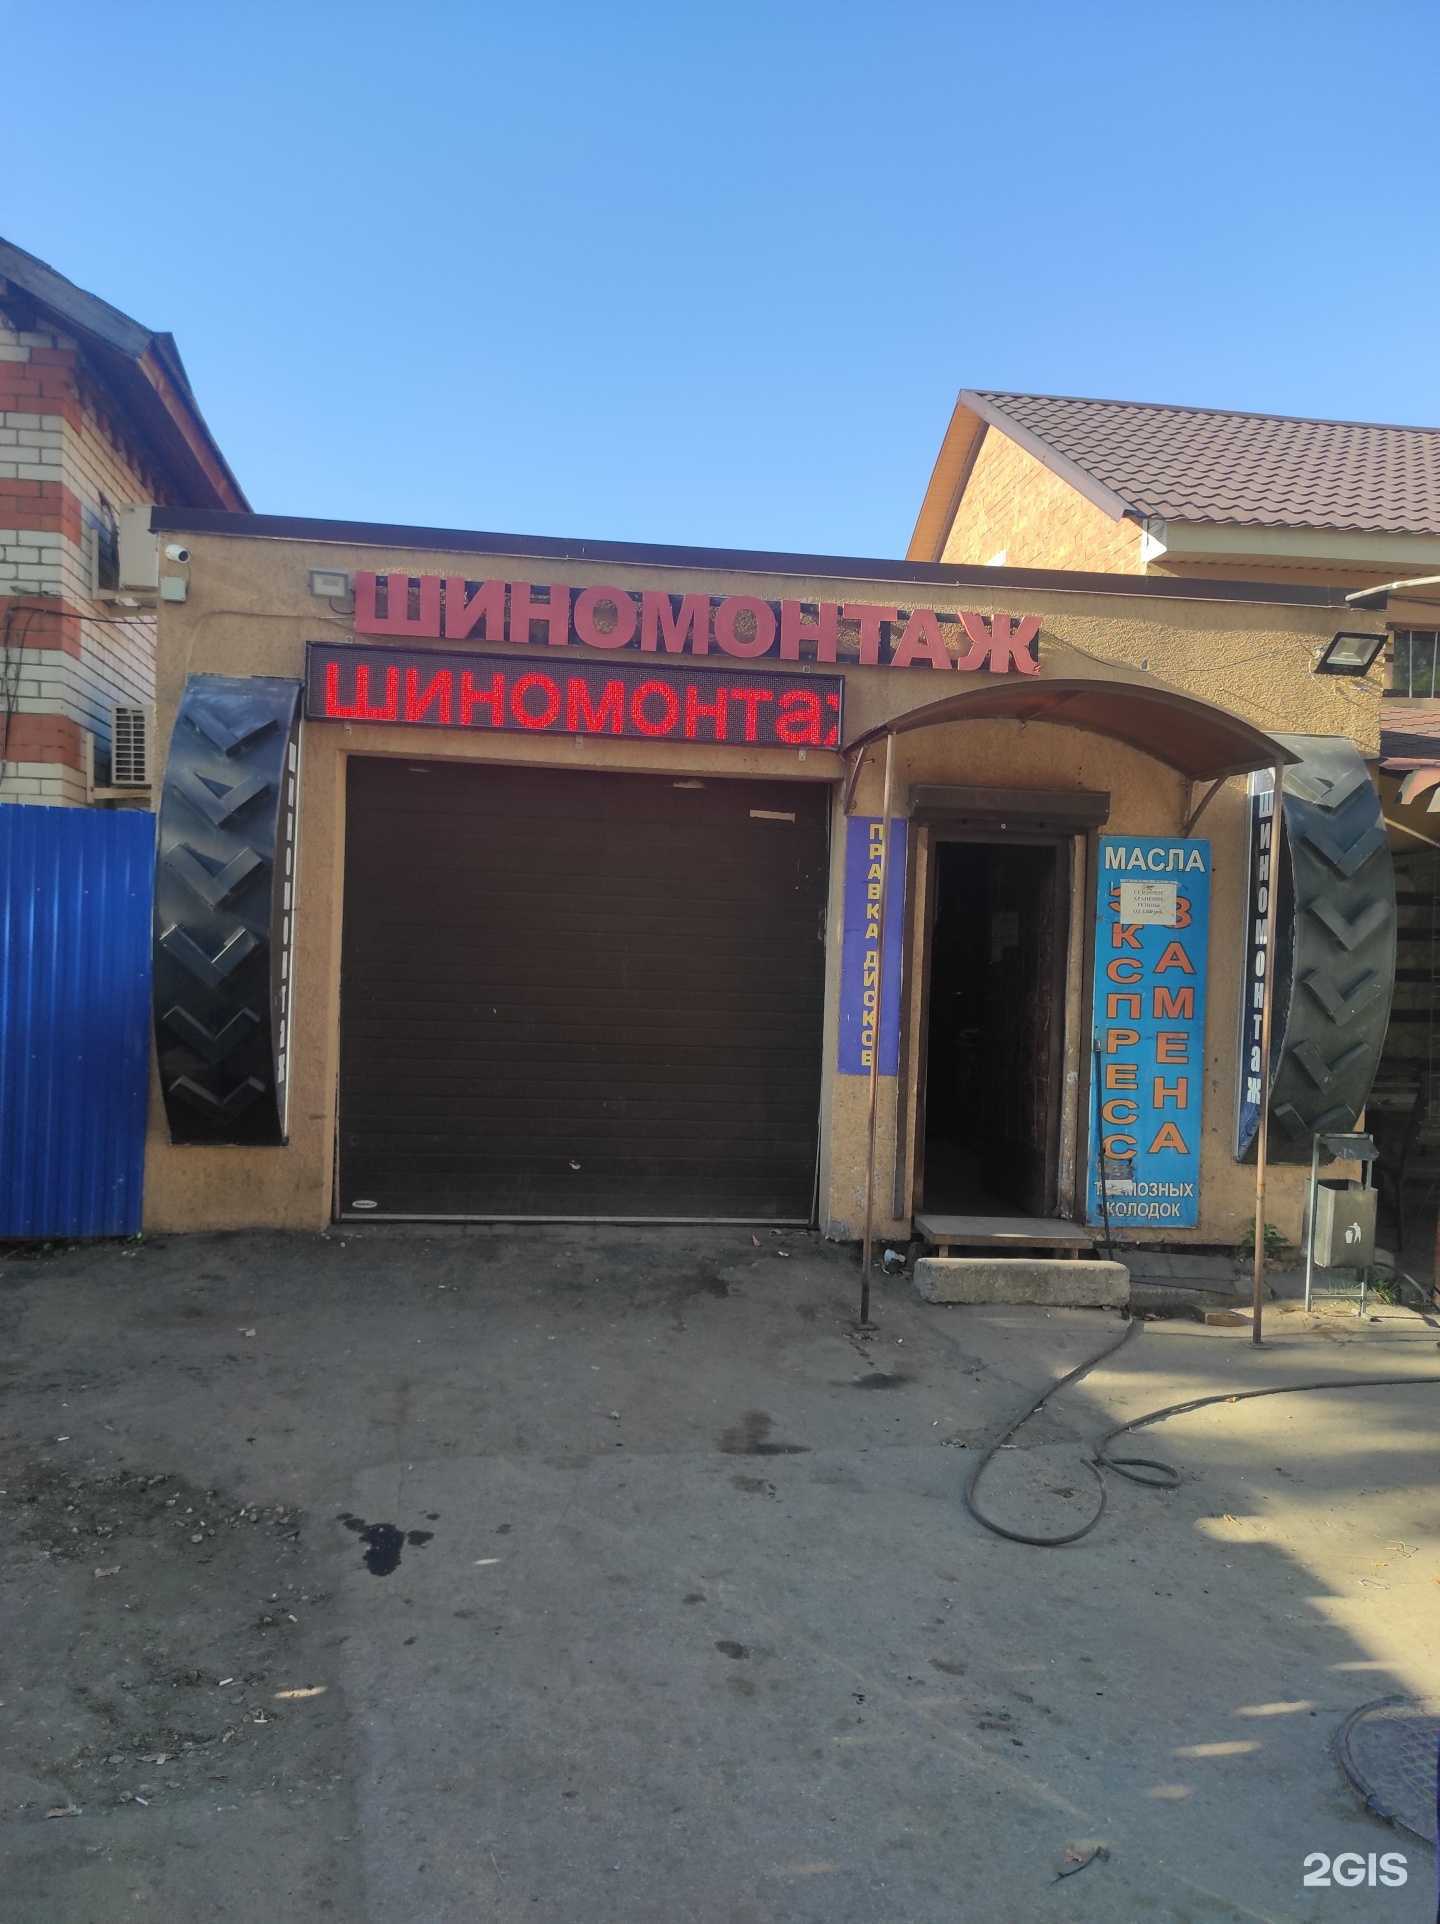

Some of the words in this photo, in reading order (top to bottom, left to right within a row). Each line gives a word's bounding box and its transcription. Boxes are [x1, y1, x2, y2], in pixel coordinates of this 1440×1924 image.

[354, 571, 1042, 676] ШИНОМОНТАЖ
[1104, 847, 1206, 873] МАСЛА
[865, 823, 884, 939] ПРАВКА
[1094, 1181, 1193, 1198] ТМОЗНЫХ
[1106, 1202, 1181, 1219] КОЛОДОК
